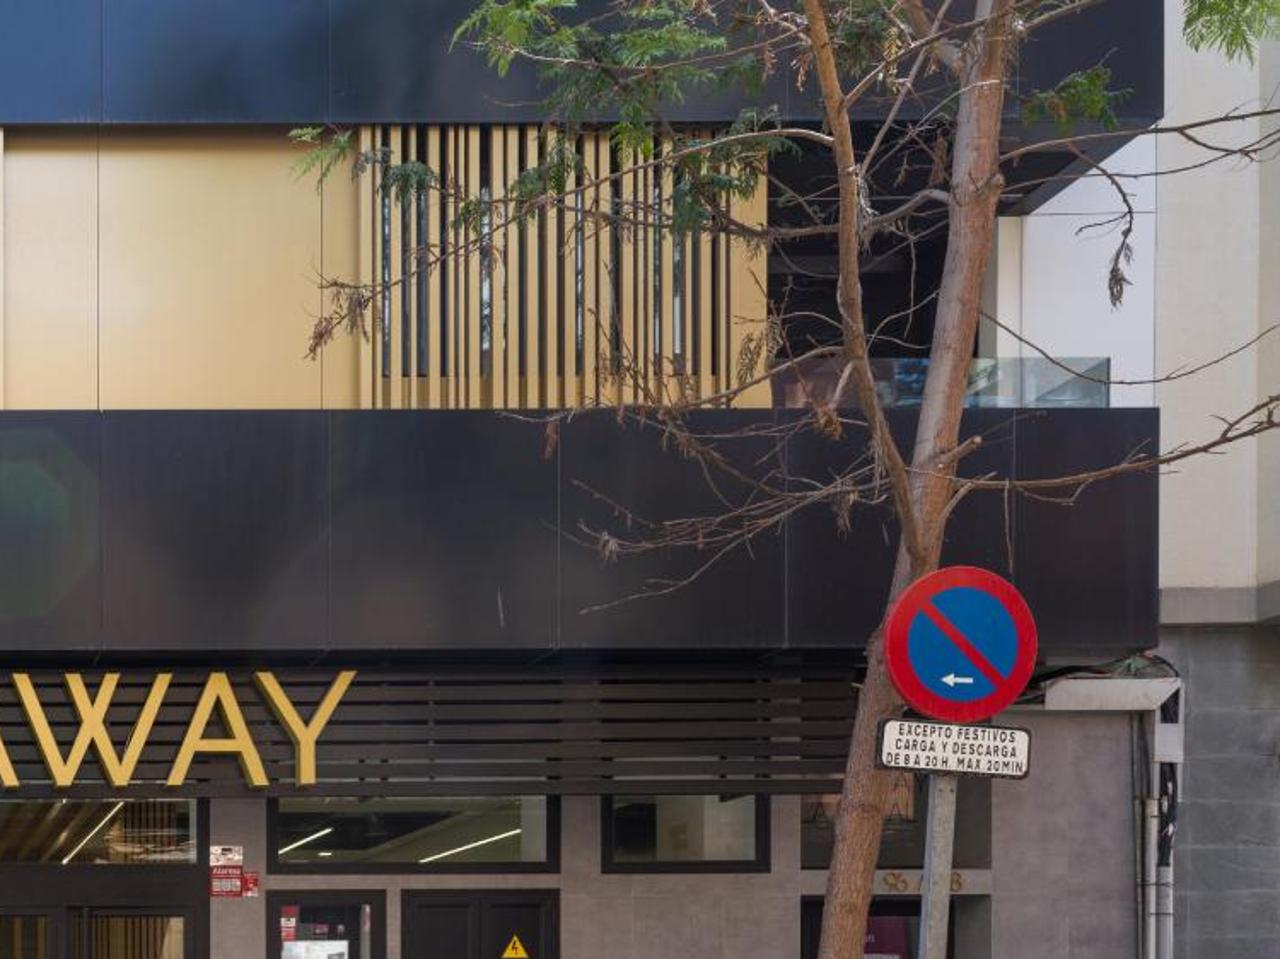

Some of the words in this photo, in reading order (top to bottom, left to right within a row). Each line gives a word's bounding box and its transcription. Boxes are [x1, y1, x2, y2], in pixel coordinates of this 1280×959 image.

[899, 723, 953, 739] EXCEPTO
[957, 728, 1017, 743] FESTIVOS
[895, 738, 936, 753] CARGA
[941, 741, 949, 754] Y
[952, 742, 1017, 758] DESCARGA
[886, 752, 900, 765] DE
[904, 753, 910, 765] 8
[914, 754, 921, 766] A
[925, 755, 938, 767] 20
